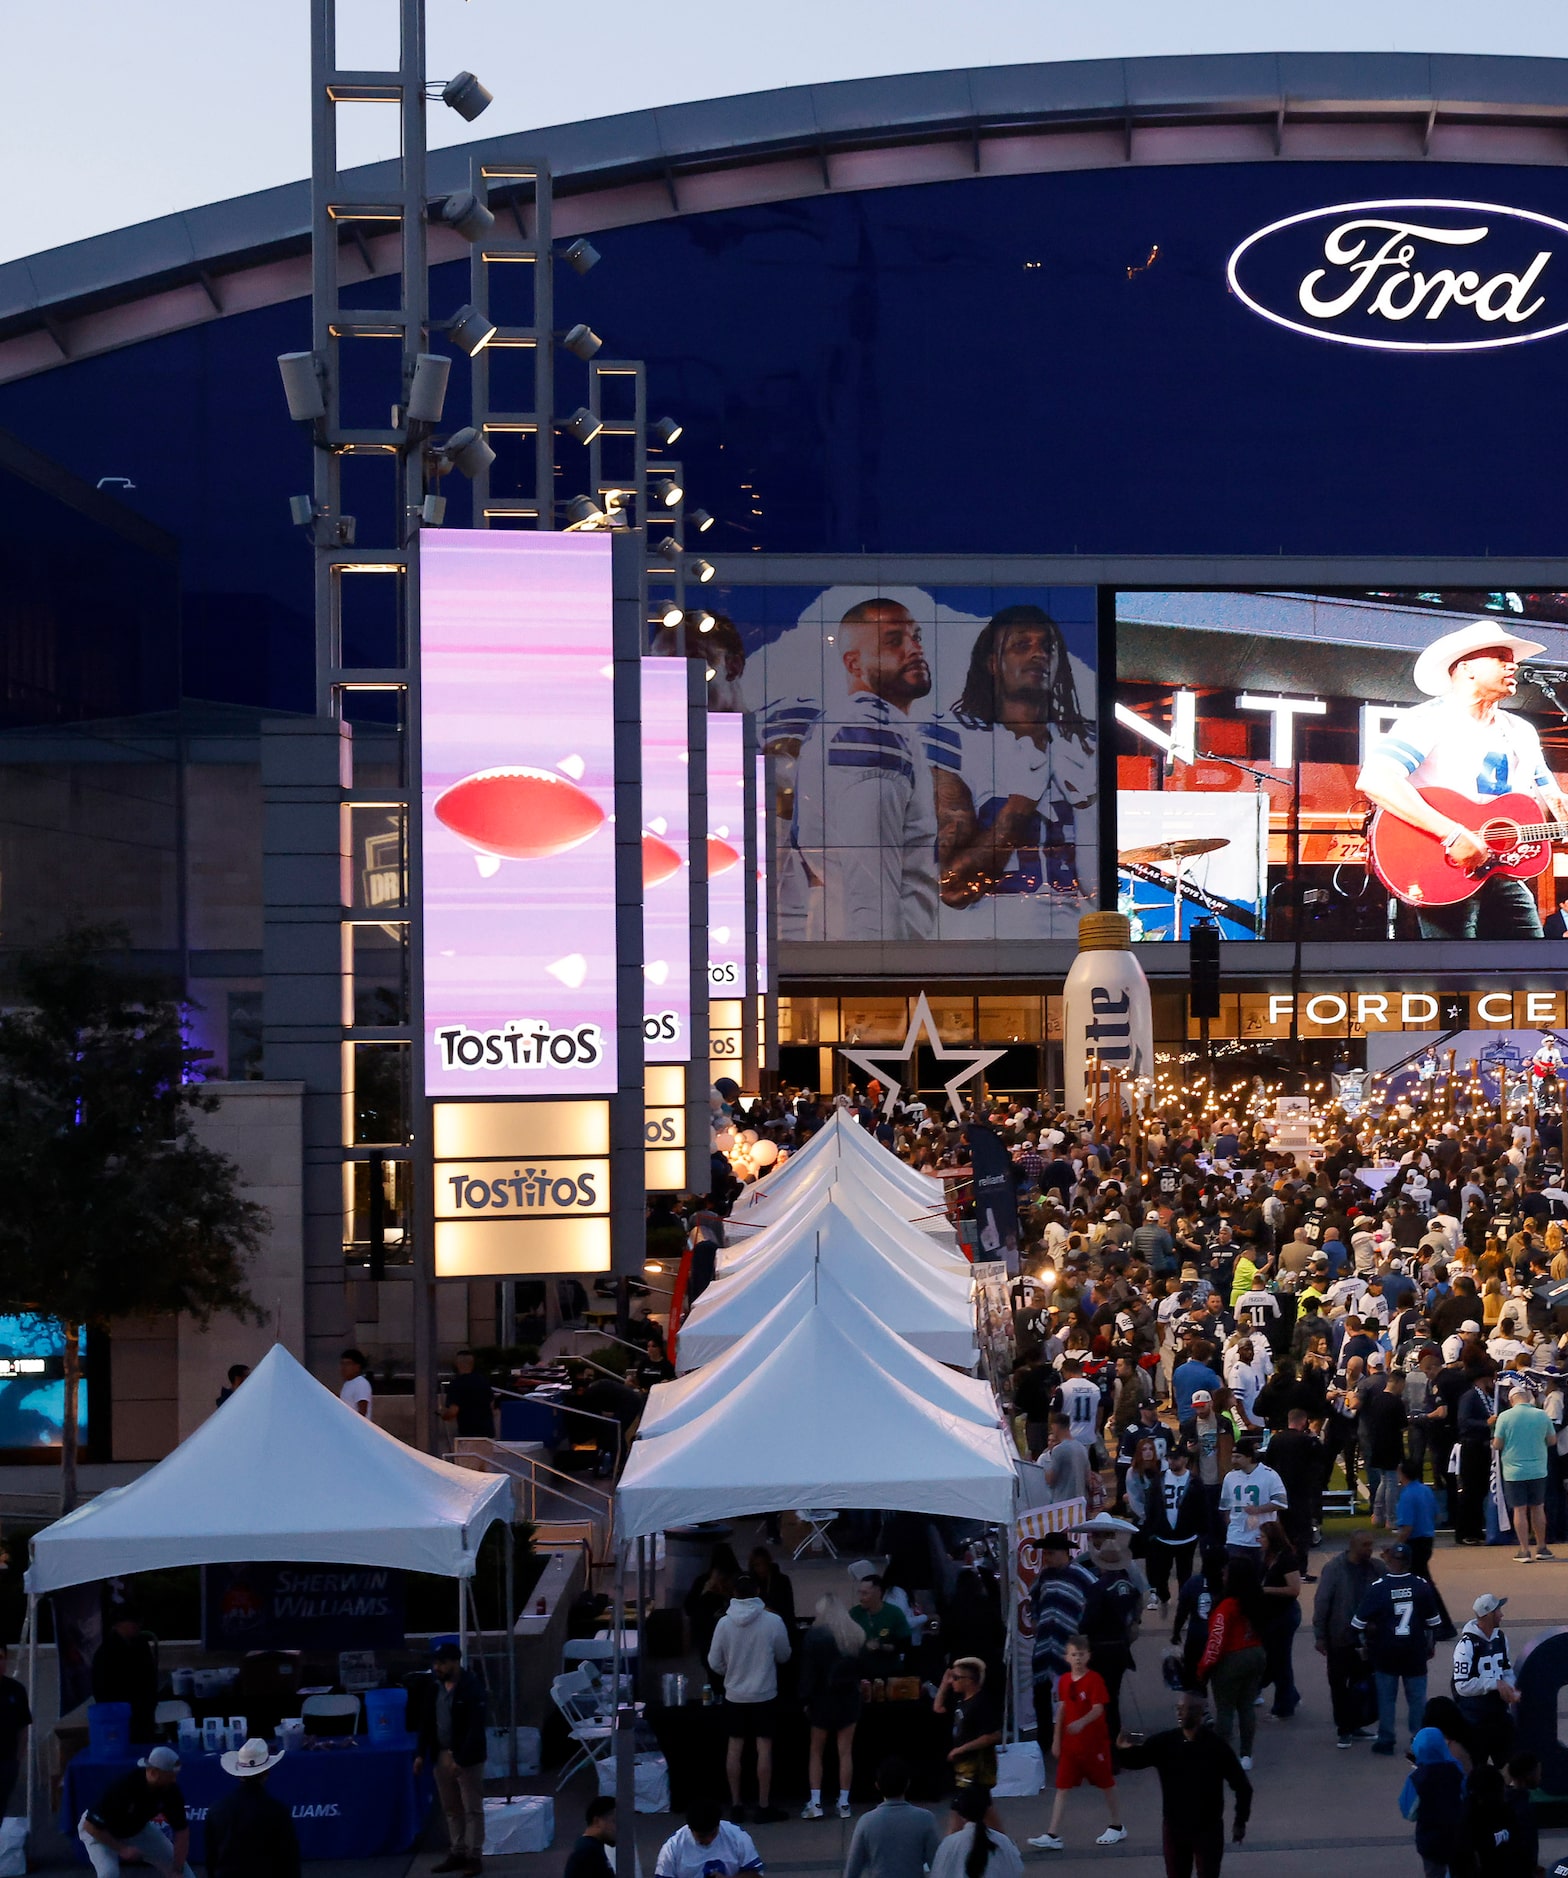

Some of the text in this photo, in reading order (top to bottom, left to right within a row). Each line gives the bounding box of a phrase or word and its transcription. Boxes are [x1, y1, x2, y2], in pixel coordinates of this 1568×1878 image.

[1299, 219, 1552, 323] Ford
[1269, 994, 1439, 1025] FORD
[440, 1024, 598, 1066] TOSTITOS
[449, 1167, 597, 1209] TOSTITOS
[1249, 1305, 1267, 1328] 11
[1073, 1395, 1091, 1422] 11
[1233, 1484, 1260, 1513] 13
[275, 1570, 388, 1593] SHERWIN
[1393, 1600, 1414, 1636] 7
